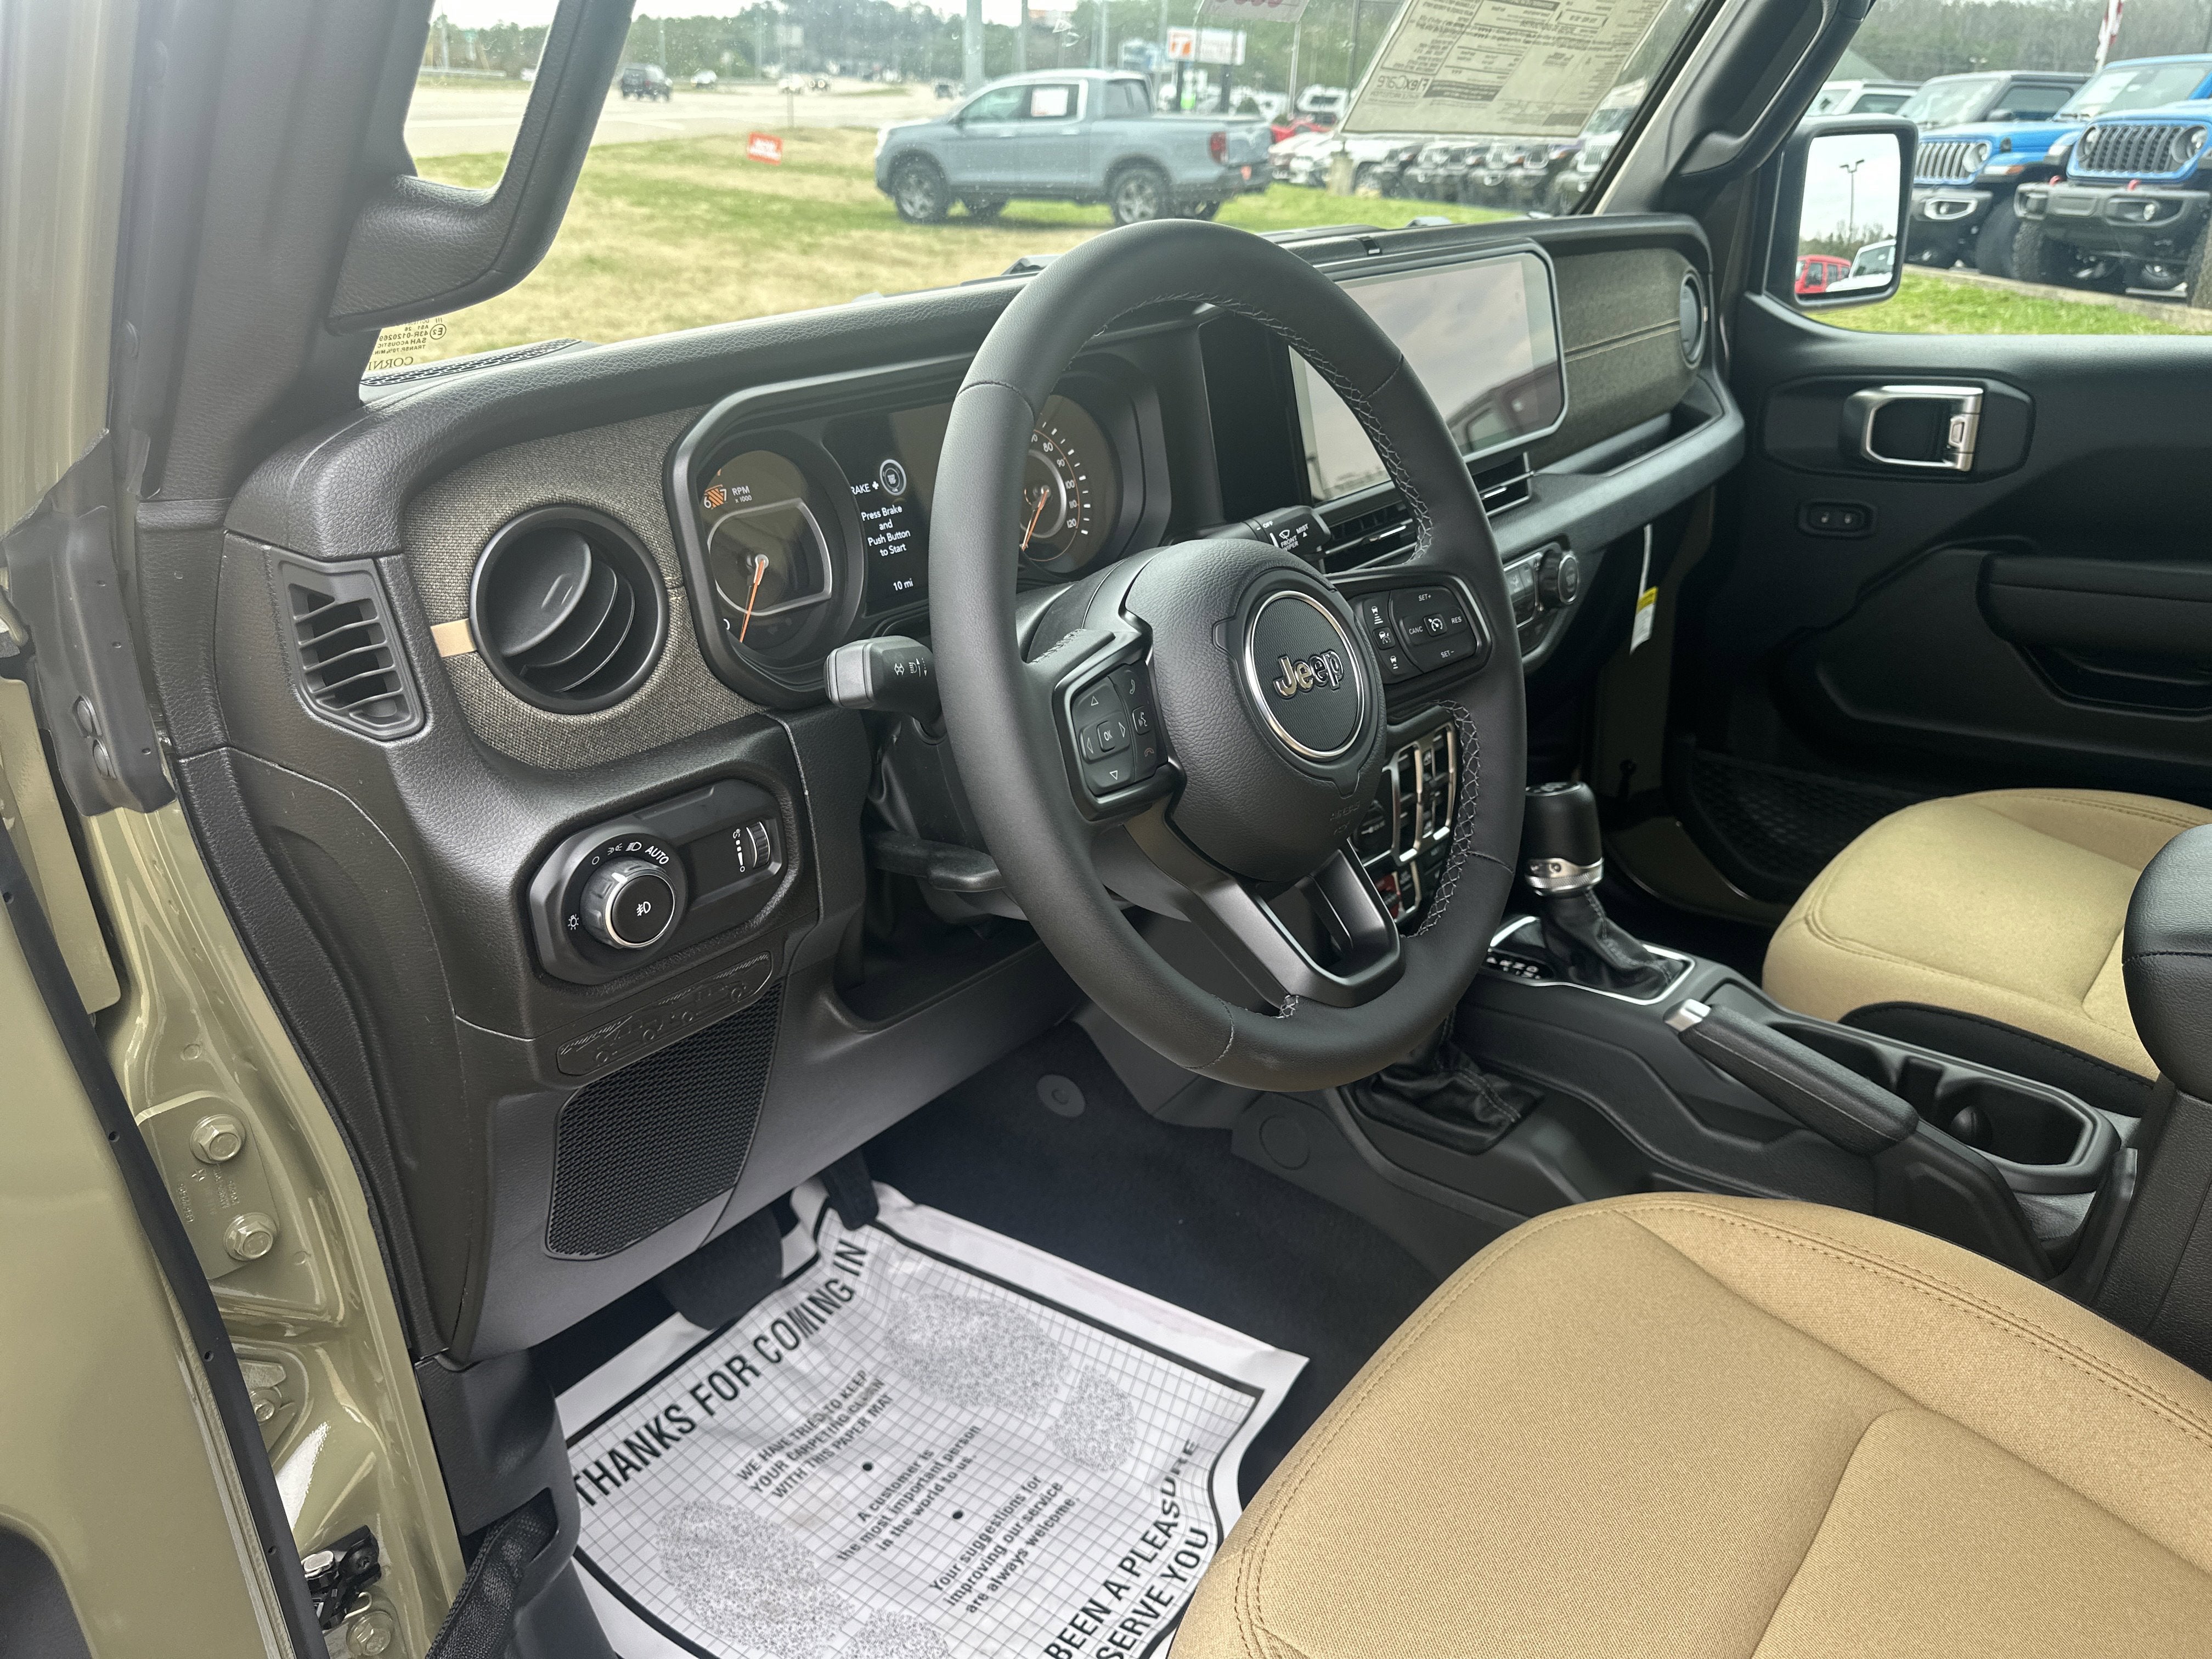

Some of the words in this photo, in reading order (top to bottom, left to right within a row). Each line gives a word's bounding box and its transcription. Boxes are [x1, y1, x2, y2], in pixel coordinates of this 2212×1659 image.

[1043, 442, 1053, 452] 80
[1057, 459, 1065, 467] 90
[732, 486, 750, 496] RPM
[851, 483, 871, 495] RAKE
[1065, 479, 1075, 489] 100
[704, 496, 712, 509] 6
[861, 511, 881, 521] Press
[881, 505, 902, 517] Brake
[879, 518, 893, 531] and
[1066, 518, 1077, 528] 120
[1296, 523, 1308, 534] MIST
[867, 534, 887, 546] Push
[887, 530, 911, 542] Button
[1280, 535, 1297, 548] FRONT
[888, 543, 906, 554] Start
[893, 580, 903, 591] 10
[904, 578, 913, 589] mi
[1451, 616, 1462, 624] RES
[1408, 626, 1423, 635] CANC
[1274, 650, 1344, 697] Jeep
[1103, 730, 1113, 741] OK
[645, 845, 669, 865] AUTO
[574, 1403, 697, 1506] THANKS
[690, 1354, 761, 1417] FOR
[752, 1278, 855, 1364] COMING
[833, 1239, 867, 1277] IN
[736, 1459, 762, 1481] WE
[758, 1436, 793, 1462] HAVE
[789, 1412, 826, 1442] TRIED
[823, 1397, 843, 1415] TO
[839, 1370, 867, 1399] KEEP
[750, 1459, 790, 1494] YOUR
[786, 1413, 851, 1462] CARPETING
[771, 1466, 809, 1499] WITH
[804, 1448, 836, 1470] THIS
[832, 1416, 871, 1450] PAPER
[867, 1393, 894, 1418] MAT
[837, 1543, 861, 1561] the
[860, 1514, 892, 1544] most
[888, 1460, 946, 1514] important
[942, 1425, 981, 1464] person
[858, 1510, 871, 1522] A
[869, 1459, 922, 1511] customer
[919, 1449, 935, 1462] is
[876, 1537, 894, 1551] in
[890, 1517, 914, 1538] the
[911, 1483, 946, 1516] world
[941, 1471, 958, 1484] to
[956, 1455, 977, 1471] us.
[929, 1564, 962, 1592] Your
[960, 1493, 1026, 1564] suggestions
[1020, 1475, 1042, 1494] for
[943, 1544, 1008, 1606] improving
[1002, 1520, 1025, 1544] our
[1022, 1481, 1063, 1523] service
[966, 1592, 989, 1614] are
[986, 1547, 1029, 1593] always
[1025, 1497, 1081, 1548] welcome.
[1096, 1585, 1175, 1658] SERVE
[1160, 1527, 1209, 1583] YOU
[1043, 1598, 1111, 1658] BEEN
[1102, 1579, 1131, 1601] A
